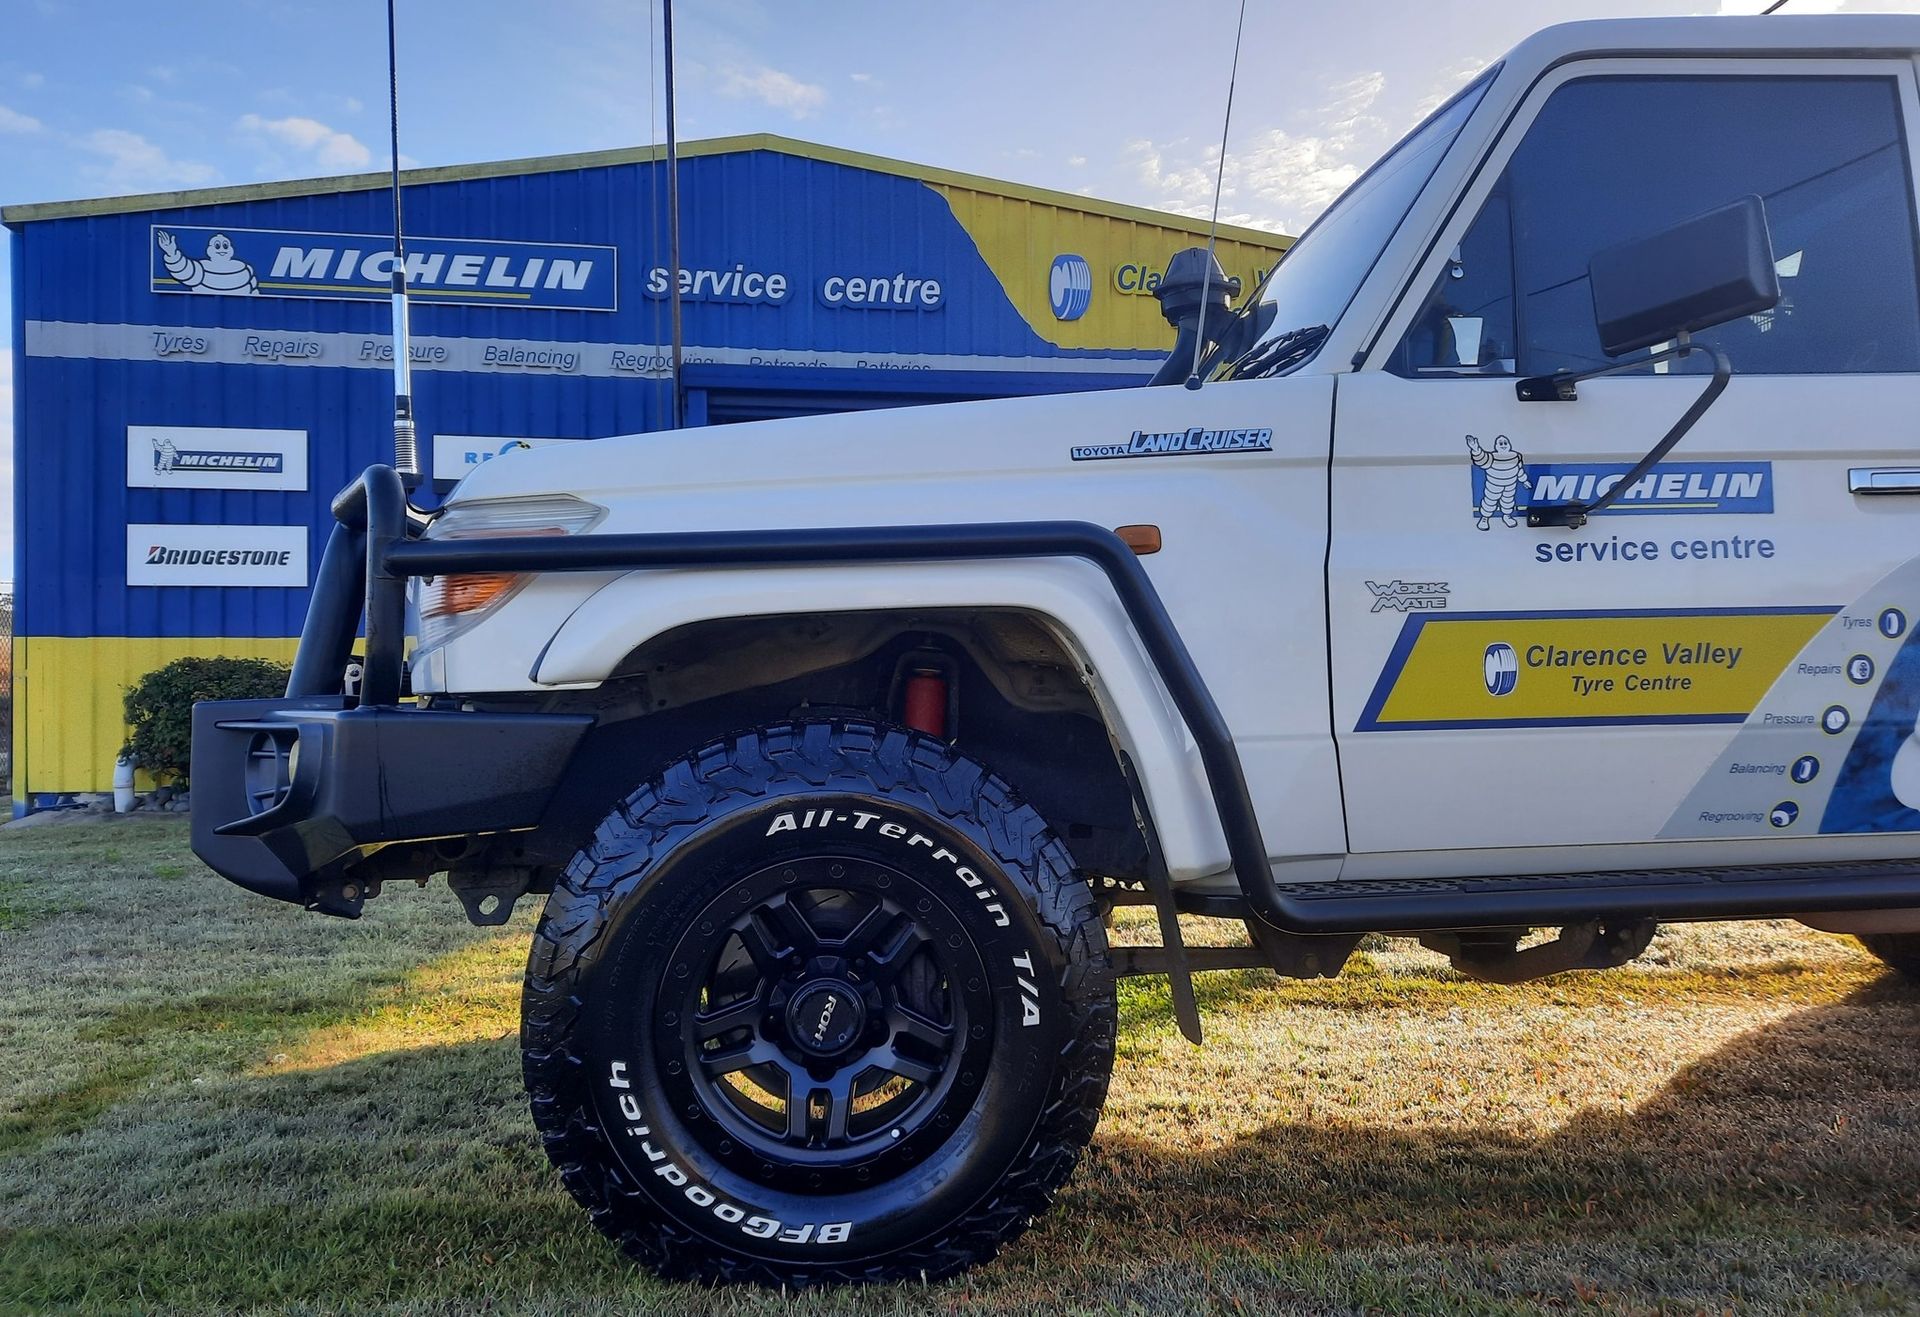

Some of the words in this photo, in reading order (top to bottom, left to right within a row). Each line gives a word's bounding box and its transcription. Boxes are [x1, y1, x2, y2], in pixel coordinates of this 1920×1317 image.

[270, 246, 594, 291] MICHELIN
[646, 265, 788, 298] service
[823, 273, 941, 305] centre
[152, 331, 205, 354] Tyres
[244, 335, 319, 357] Repairs
[361, 340, 445, 358] Presure
[484, 345, 575, 369] Balancing
[179, 453, 279, 469] MICHELIN
[1075, 446, 1124, 457] TOYOTA
[1533, 473, 1763, 501] MICHELIN
[145, 545, 290, 566] BRIDGESTONE
[1535, 536, 1658, 562] service
[1670, 535, 1775, 560] centre
[1365, 580, 1451, 596] WORK
[1371, 597, 1446, 613] MATE
[1842, 616, 1872, 630] Tyres
[1525, 644, 1647, 667] Clarence
[1661, 642, 1743, 669] Valley
[1797, 663, 1842, 677] Repairs
[1571, 675, 1614, 696] Tyre
[1624, 674, 1692, 692] Centre
[1763, 712, 1815, 725] Pressure
[1729, 763, 1786, 776] Balancing
[1698, 810, 1765, 823] Regrooving
[765, 809, 1010, 927] All-Terrain
[1012, 950, 1040, 1027] T/A
[814, 995, 837, 1041] ROH
[609, 1060, 853, 1244] BFGoodrich
